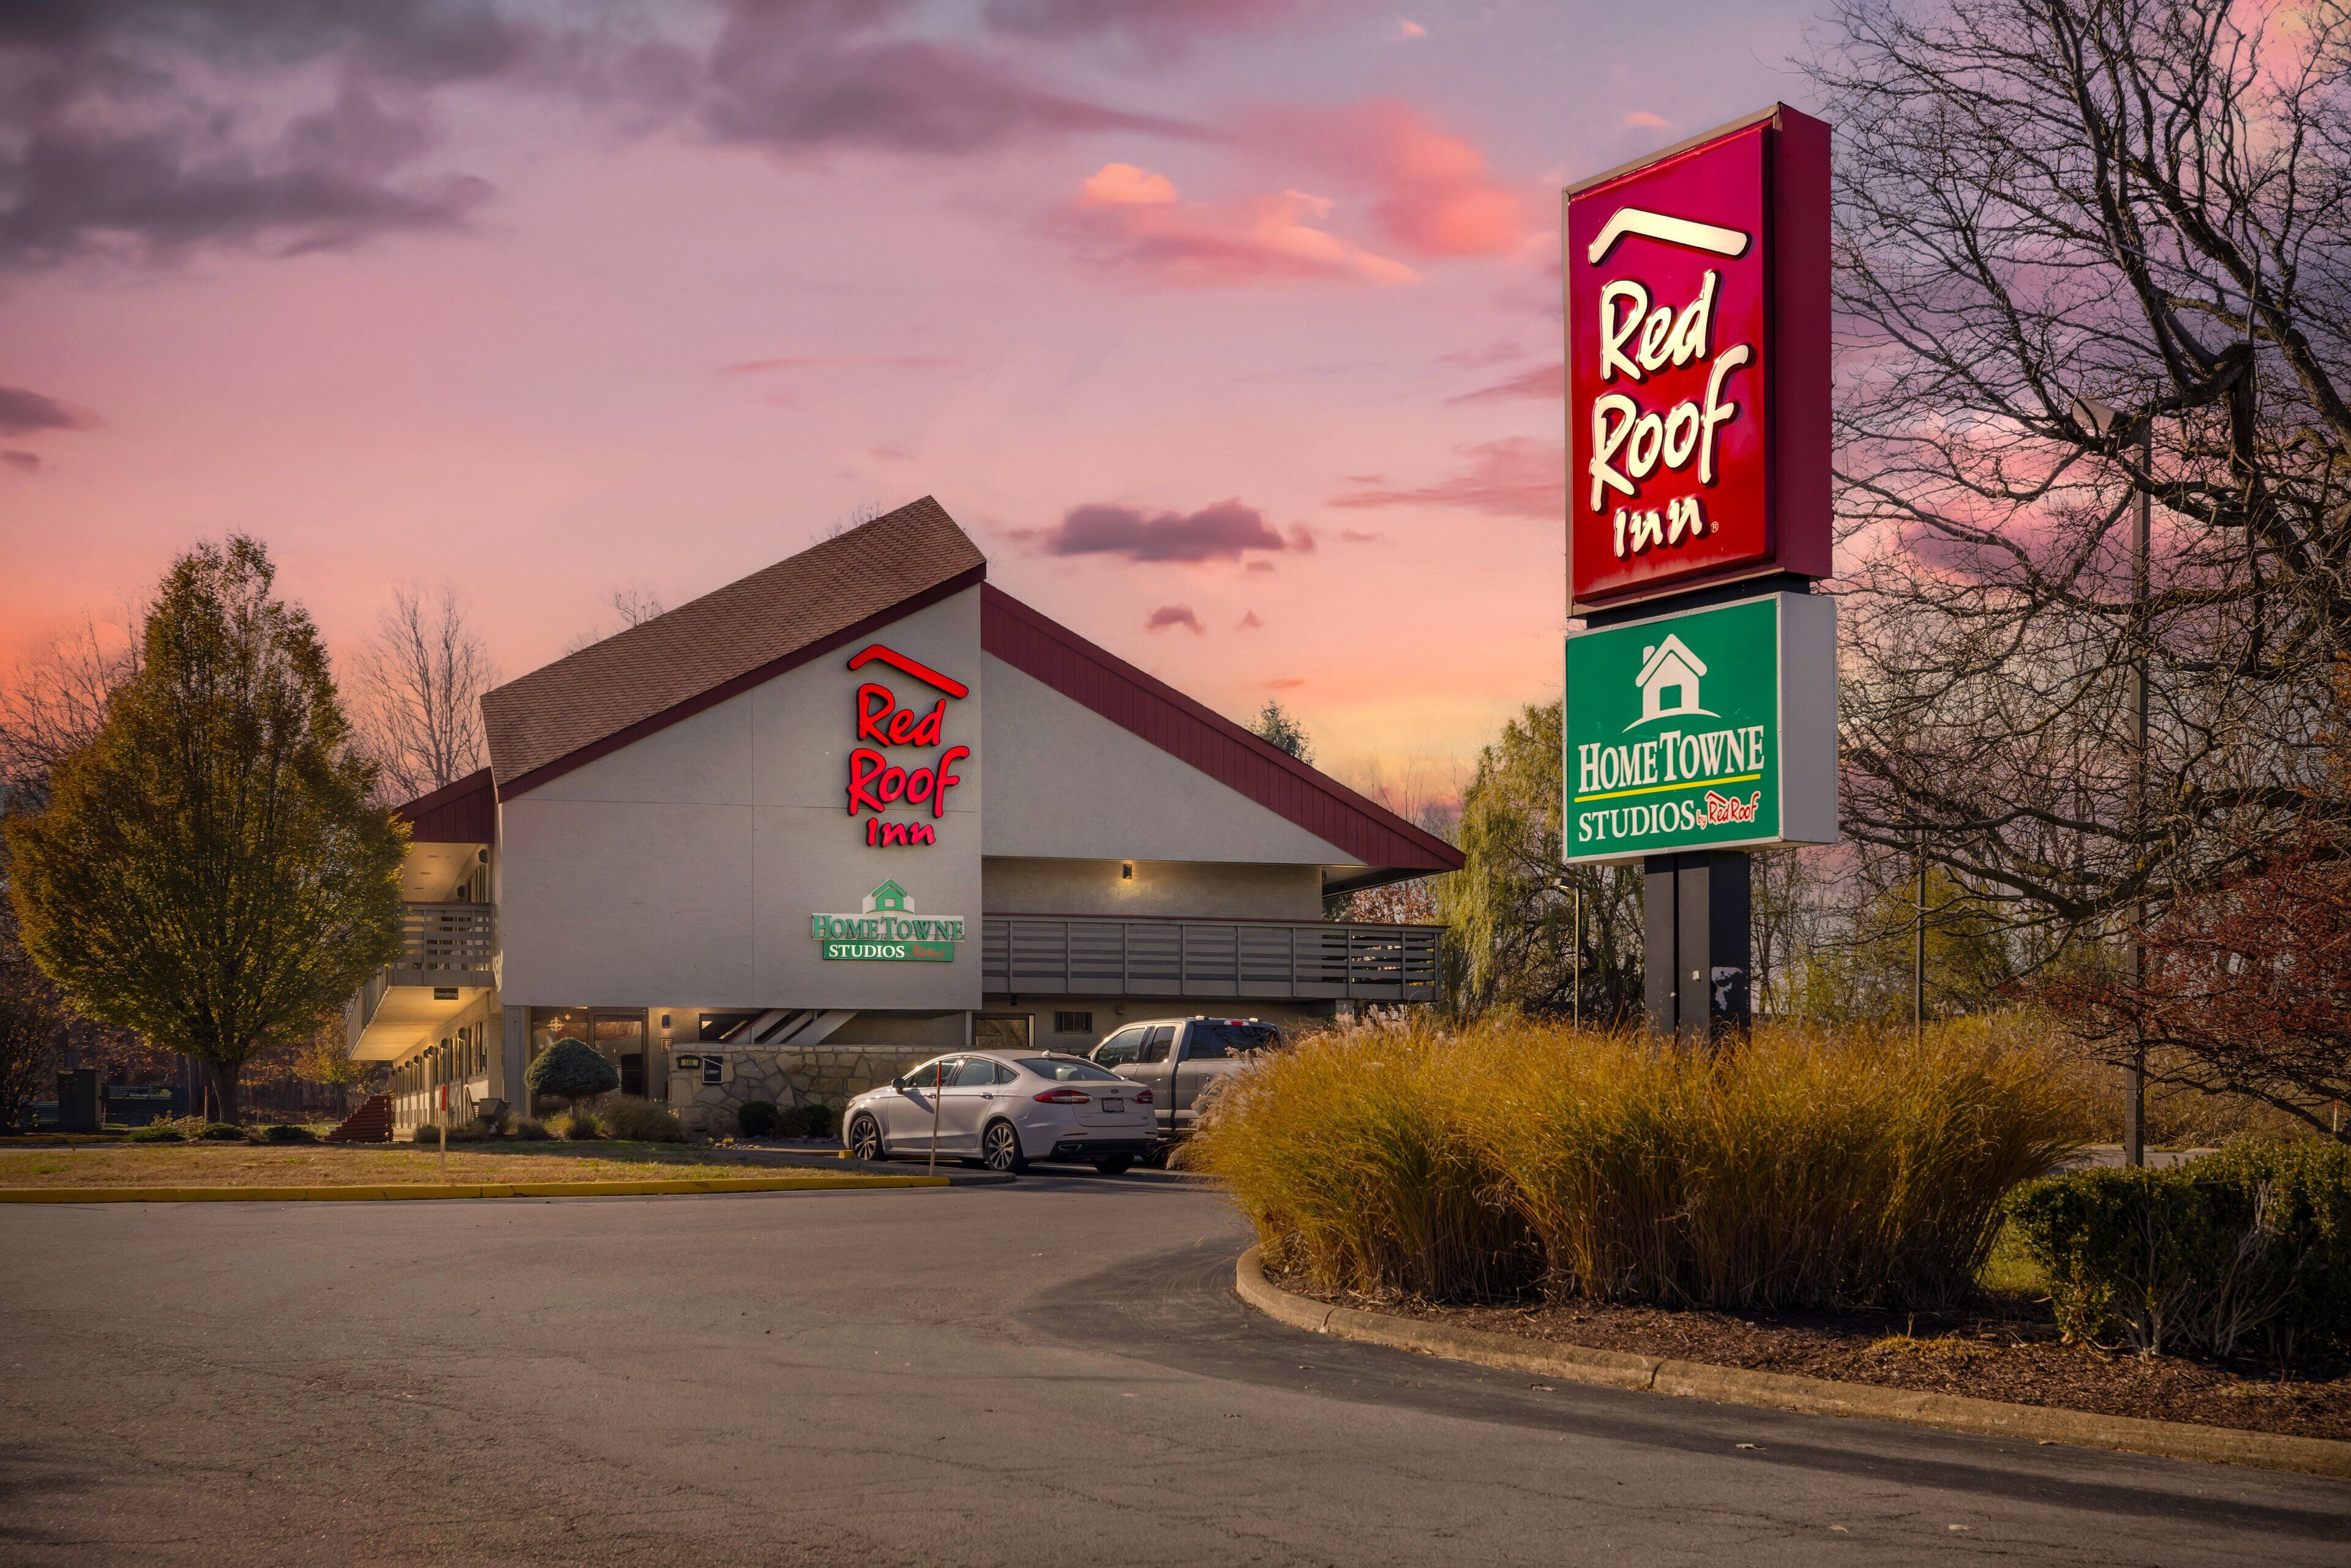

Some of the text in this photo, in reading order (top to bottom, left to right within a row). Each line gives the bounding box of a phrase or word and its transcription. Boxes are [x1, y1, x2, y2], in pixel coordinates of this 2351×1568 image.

[1600, 269, 1717, 381] Red
[1591, 344, 1749, 512] Roof
[857, 683, 947, 748] Red
[846, 745, 970, 819] Roof
[1578, 791, 1760, 842] STUDIOS by Red Roof
[828, 944, 906, 958] STUDIOS
